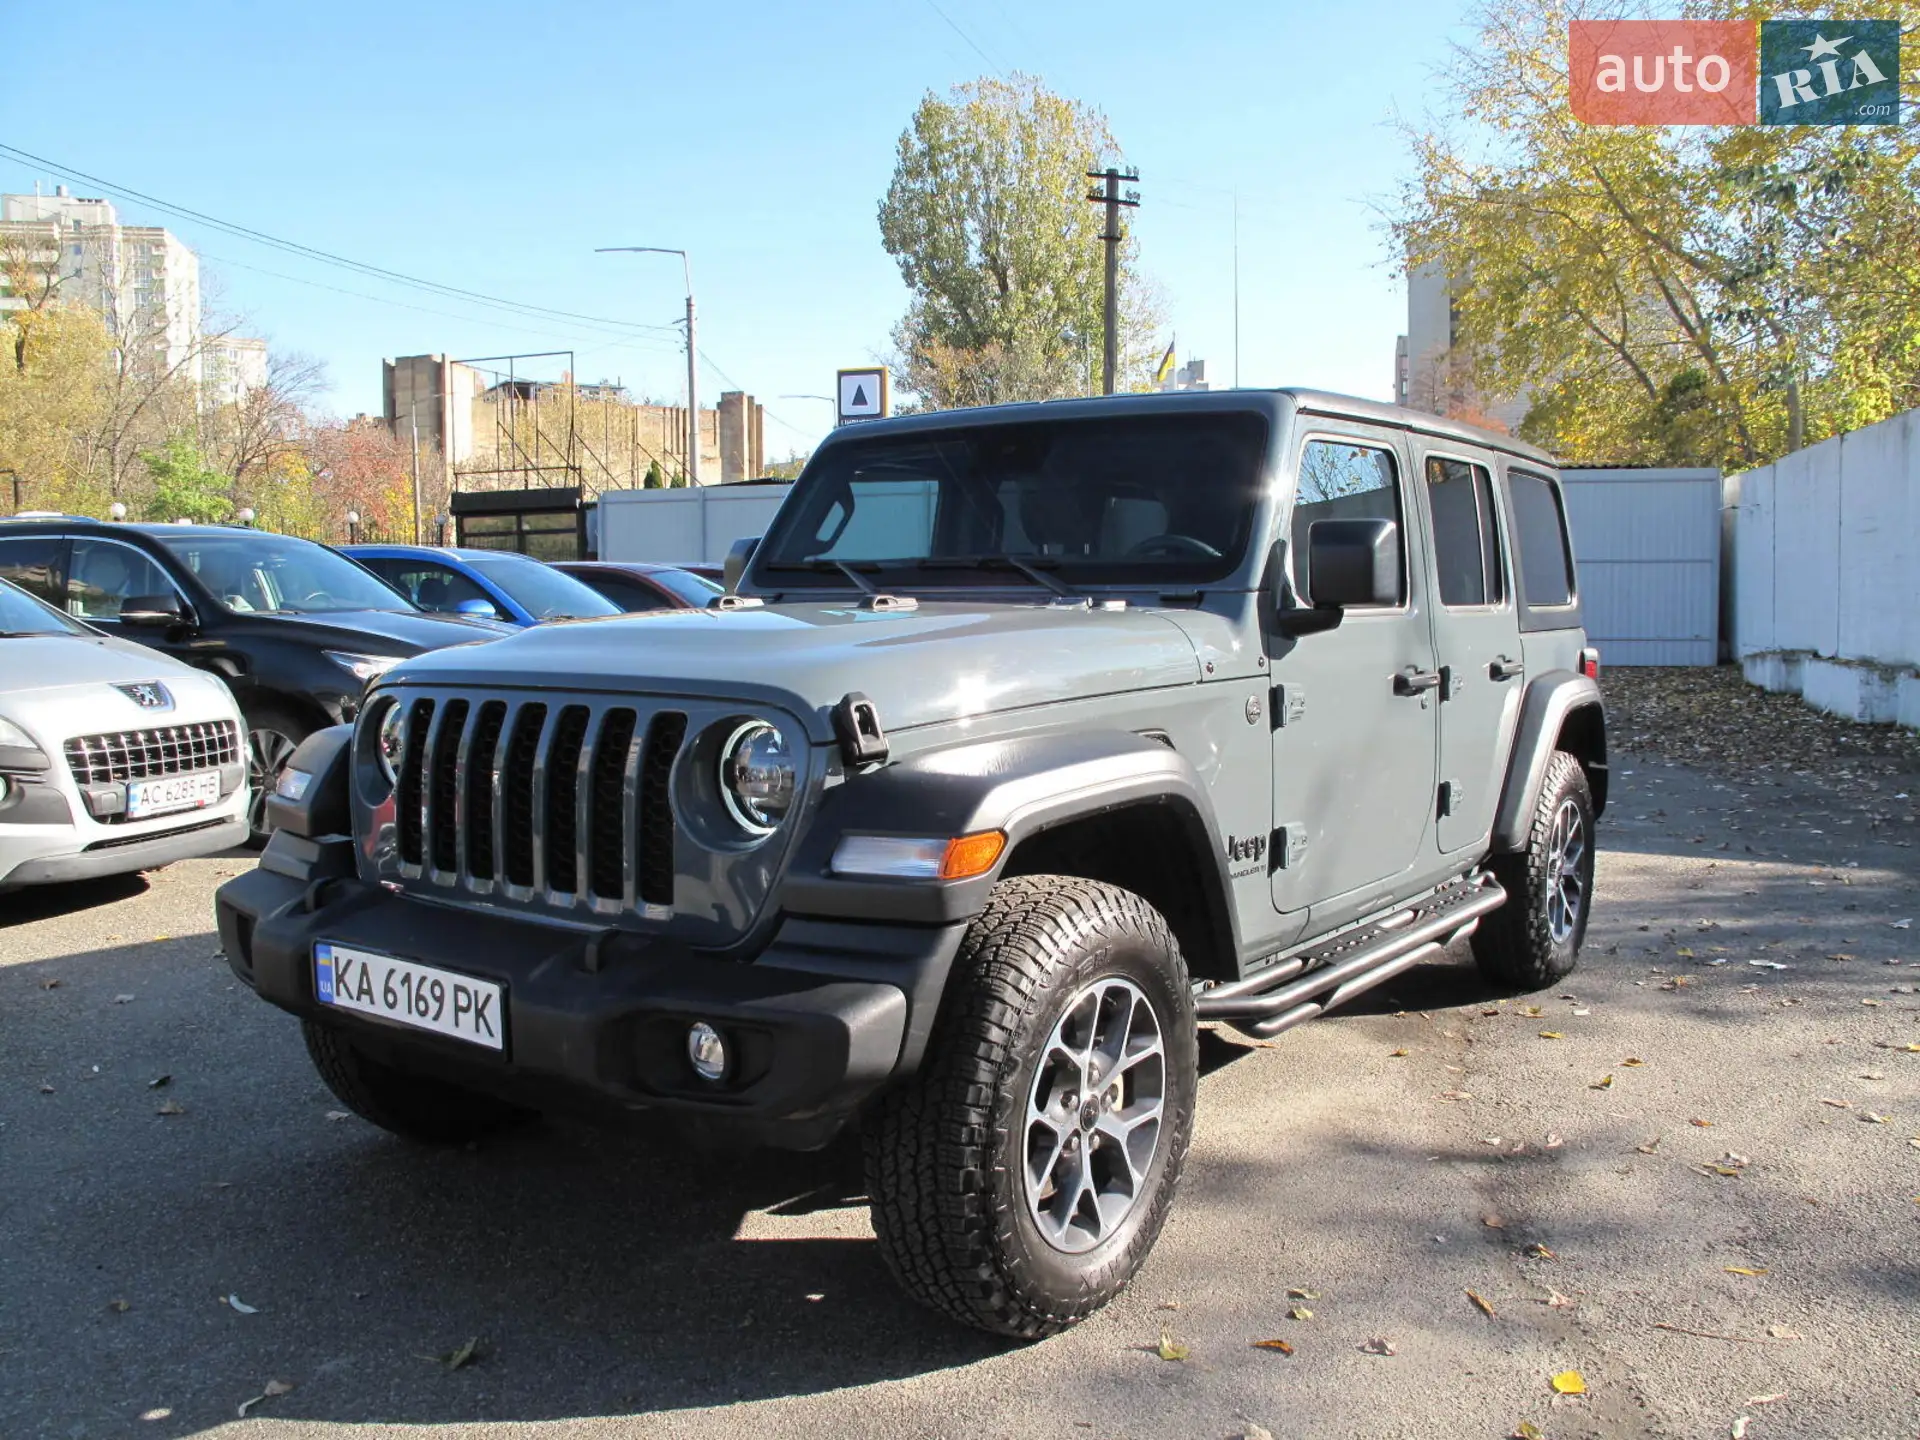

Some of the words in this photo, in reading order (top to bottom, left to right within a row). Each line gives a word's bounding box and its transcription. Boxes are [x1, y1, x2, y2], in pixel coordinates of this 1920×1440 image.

[140, 785, 161, 806] AC
[1228, 834, 1267, 862] Jeep
[319, 981, 333, 993] UA
[334, 956, 375, 1005] KA
[383, 967, 445, 1022] 6169
[453, 983, 495, 1038] PK
